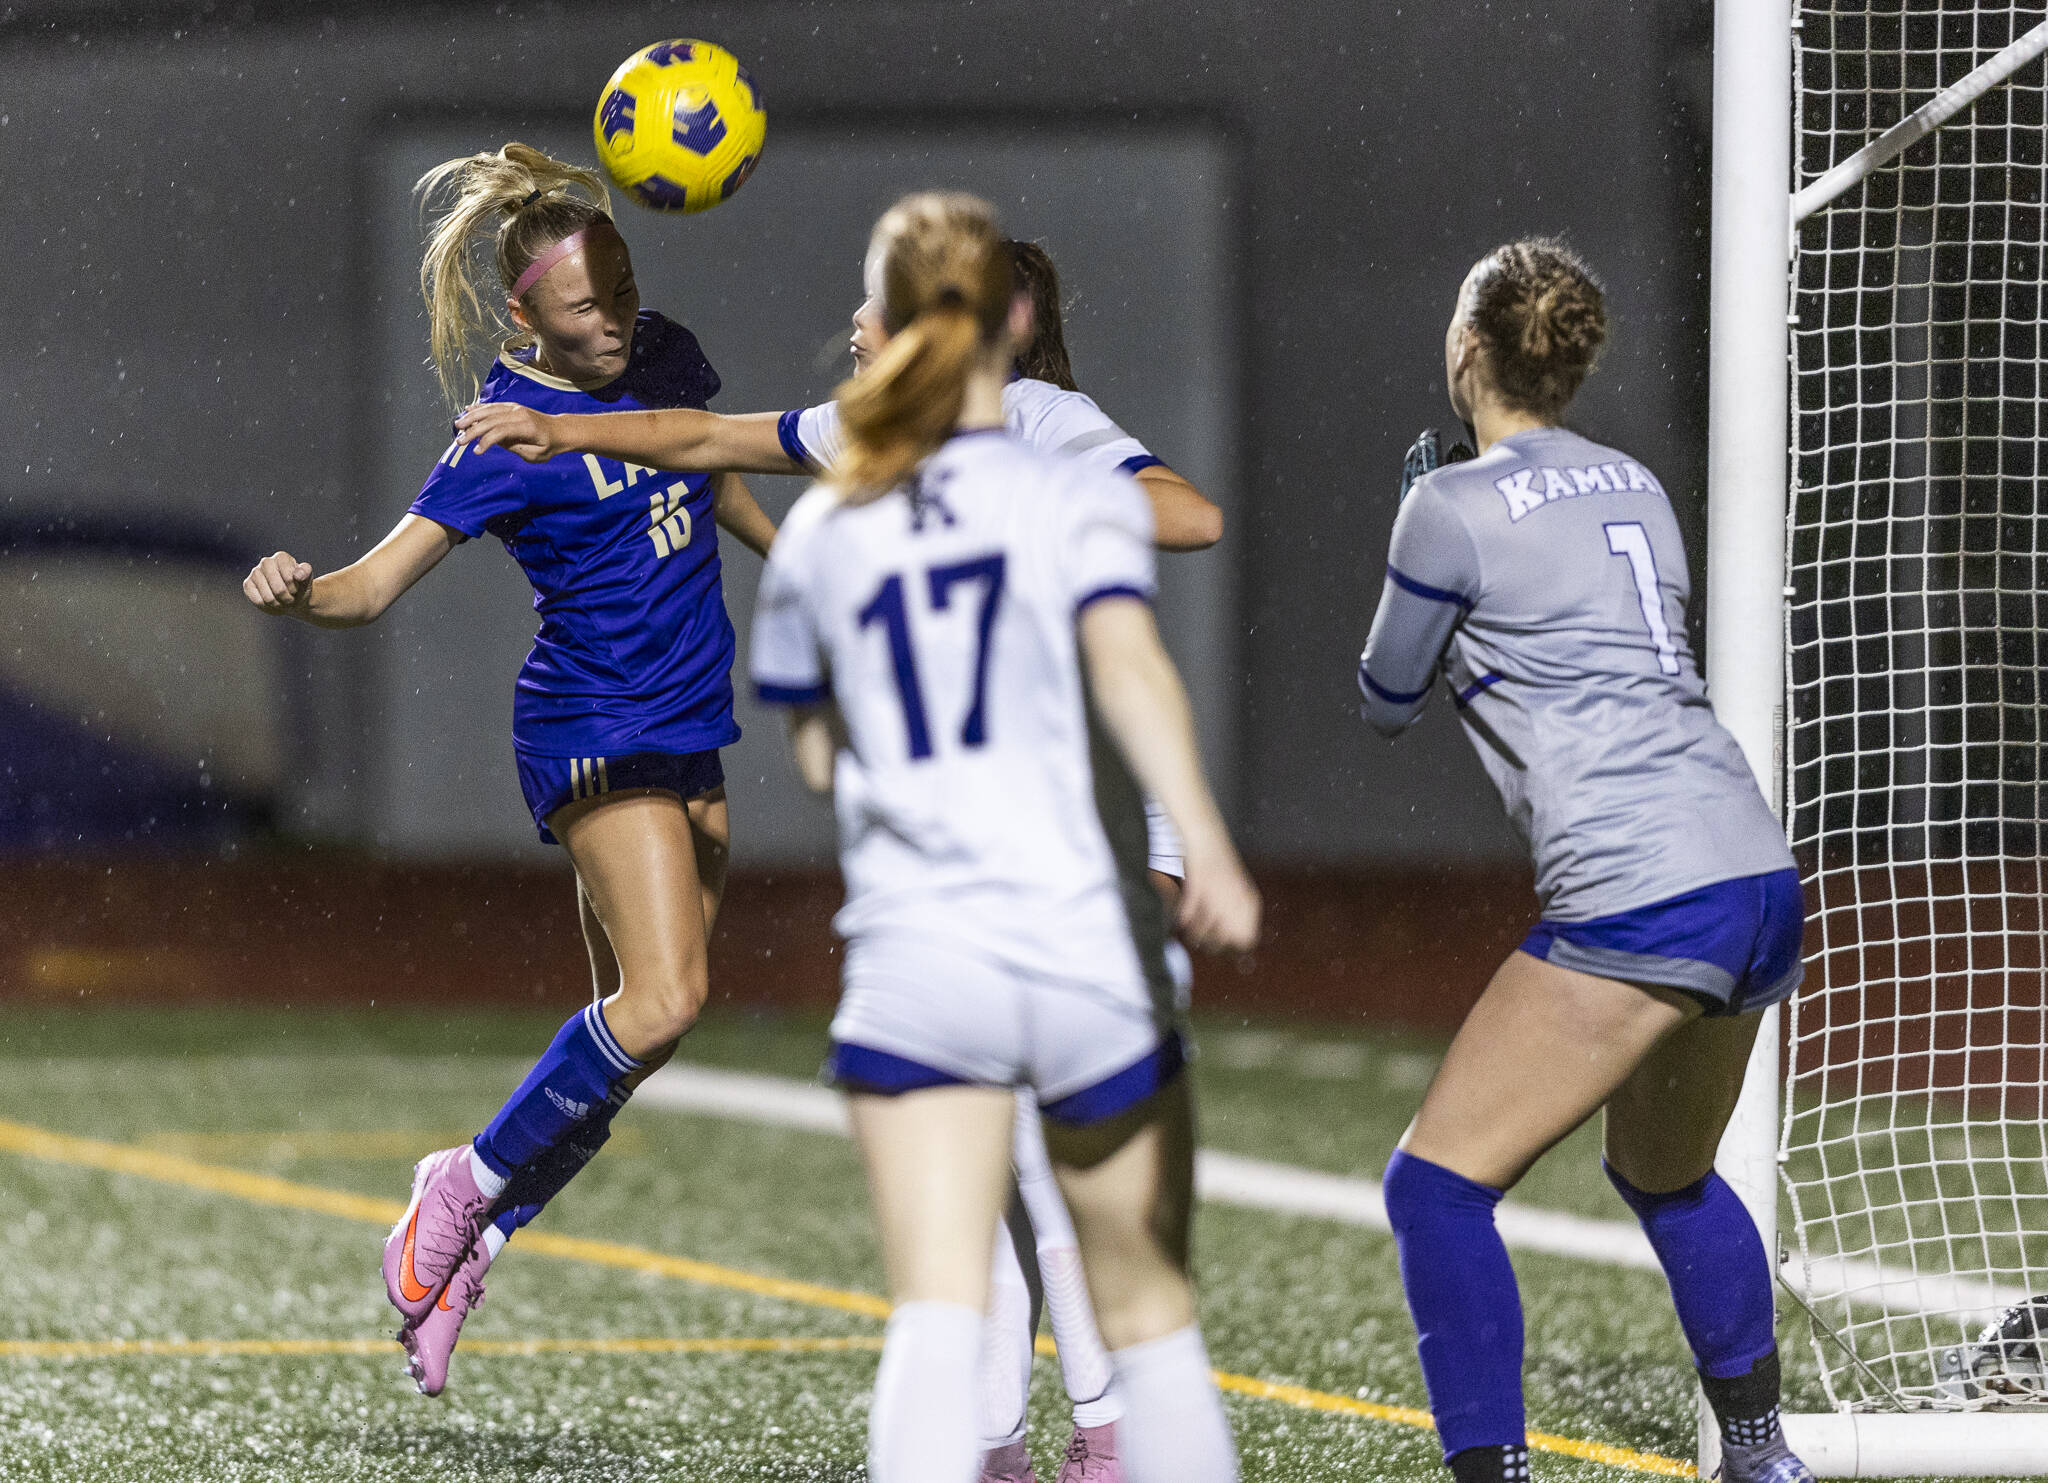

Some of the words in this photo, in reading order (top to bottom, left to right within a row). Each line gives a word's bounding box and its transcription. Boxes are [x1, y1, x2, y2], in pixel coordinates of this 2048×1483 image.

[648, 480, 691, 559] 16
[858, 552, 1006, 760] 17
[1603, 521, 1680, 676] 1
